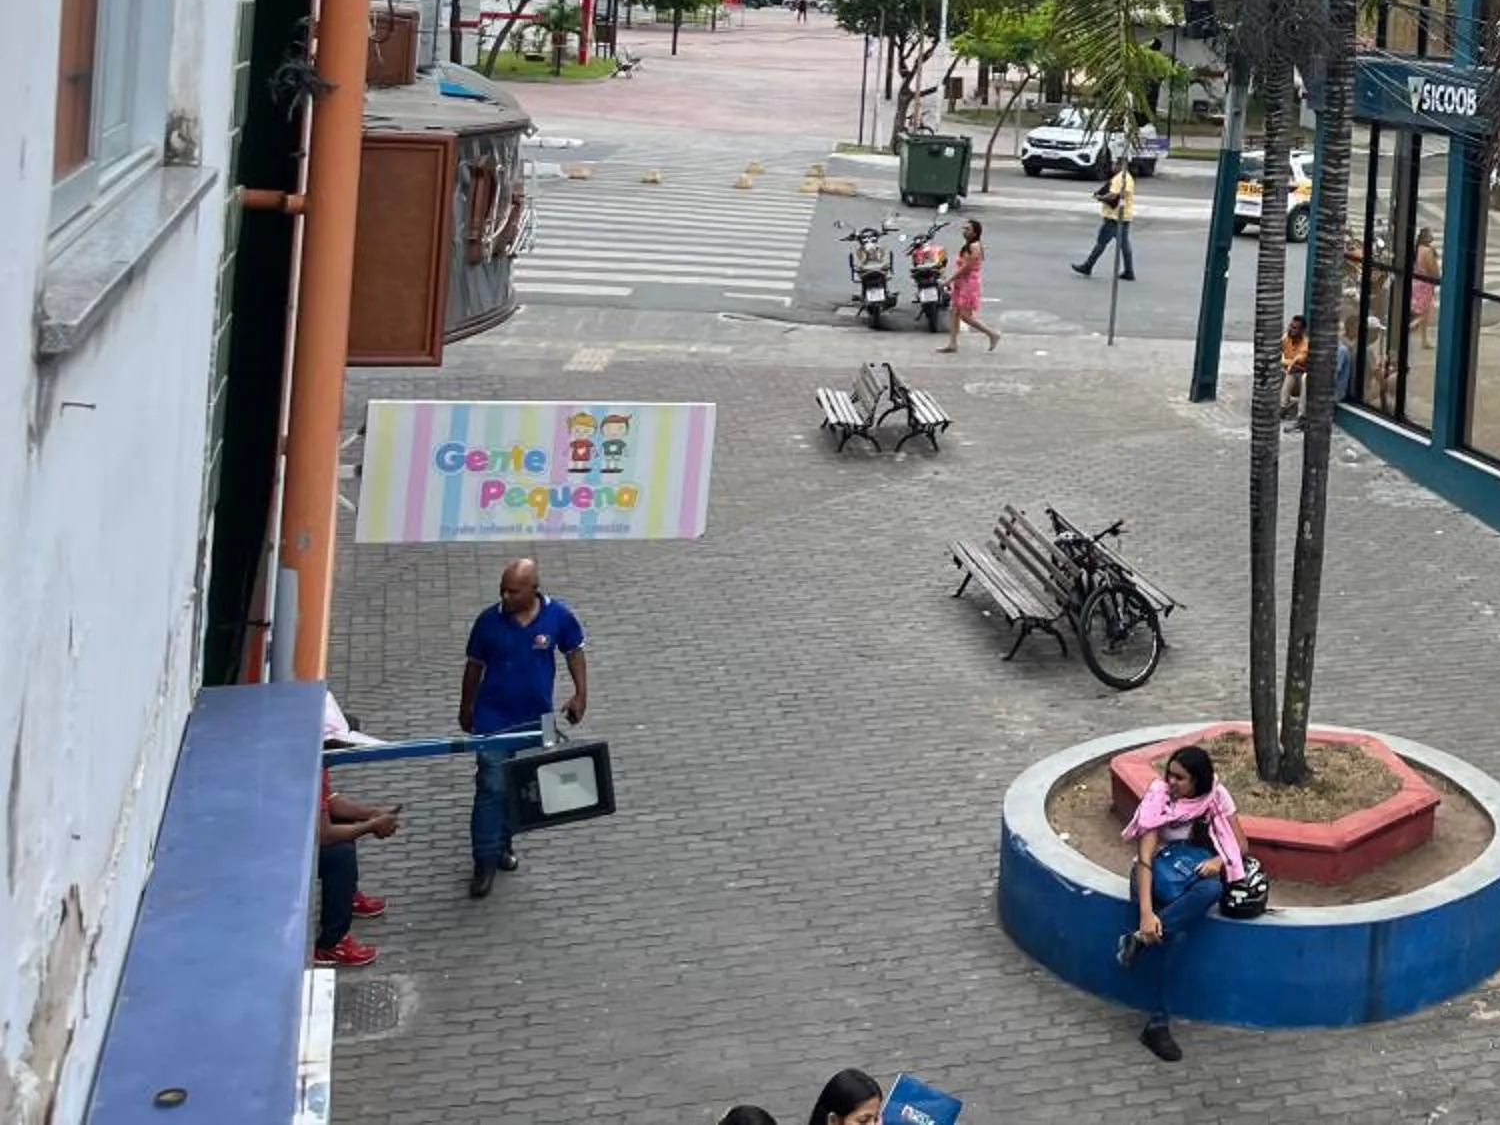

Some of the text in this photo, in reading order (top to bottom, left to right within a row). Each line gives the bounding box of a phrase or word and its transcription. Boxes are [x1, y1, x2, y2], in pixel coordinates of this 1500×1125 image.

[1421, 82, 1477, 116] SICOOB
[436, 441, 547, 474] Gente
[480, 480, 638, 517] Pequena
